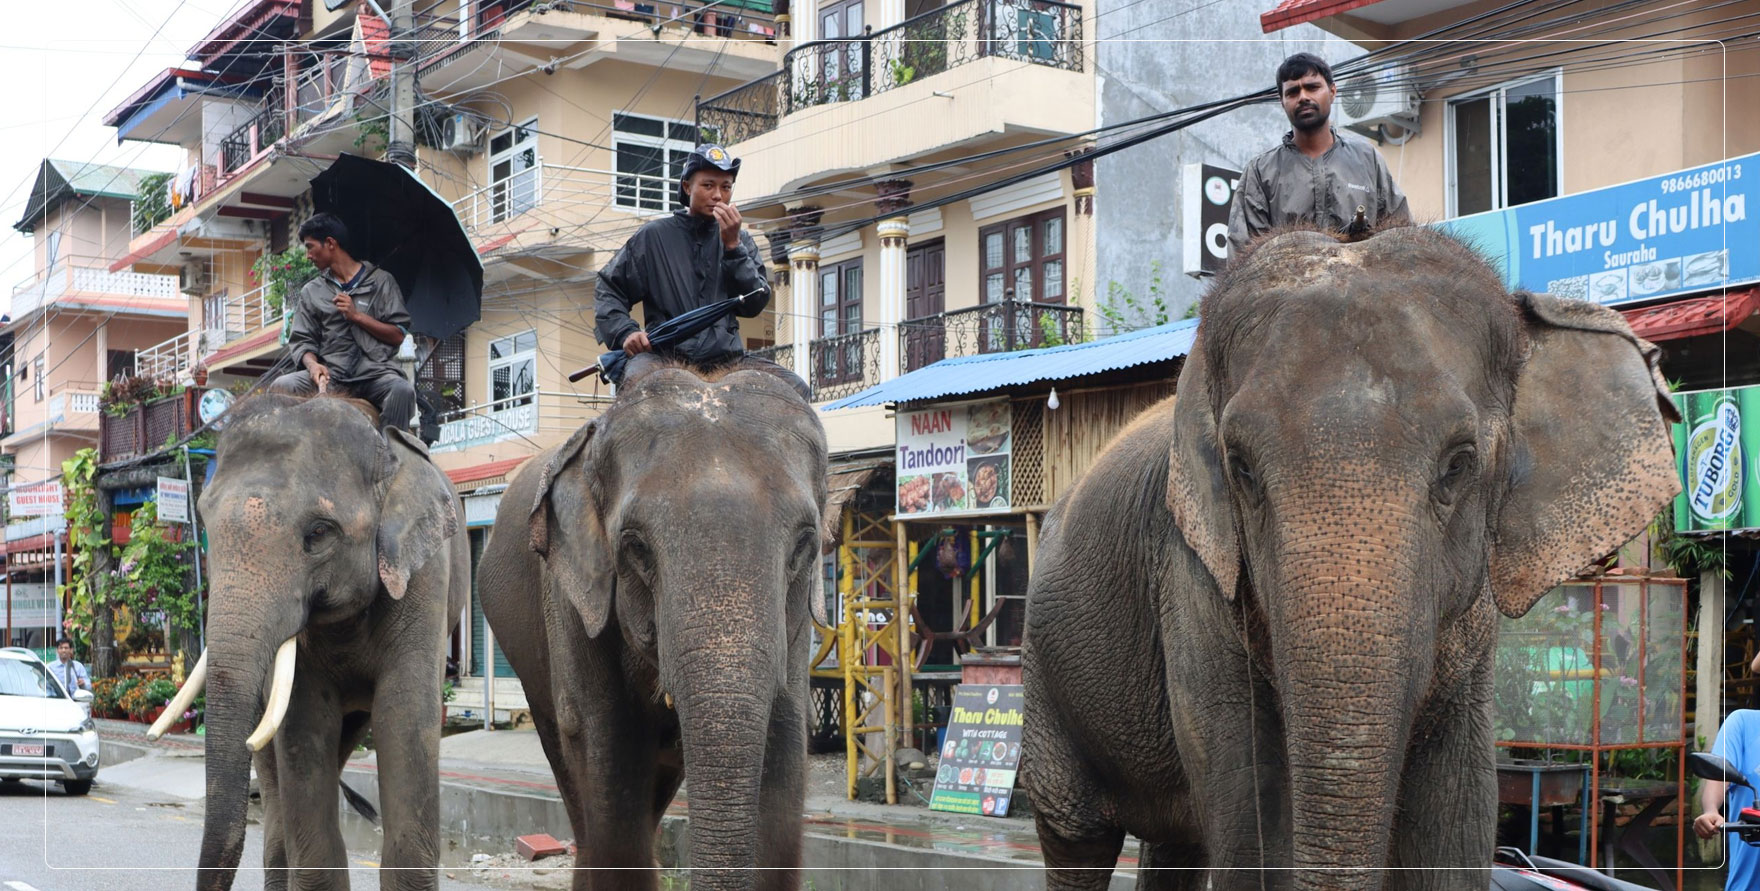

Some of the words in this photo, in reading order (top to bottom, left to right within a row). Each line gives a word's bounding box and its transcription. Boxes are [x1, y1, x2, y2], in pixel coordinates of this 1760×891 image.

[1661, 164, 1742, 194] 9866680013
[1530, 219, 1617, 260] Tharu
[1629, 188, 1746, 241] Chulha
[1604, 243, 1657, 269] Sauraha
[469, 415, 496, 440] GUEST
[499, 406, 531, 432] HOUSE
[911, 409, 952, 436] NAAN
[900, 438, 965, 470] Tandoori
[1694, 428, 1734, 510] TUBORG
[16, 495, 37, 504] GUEST
[38, 494, 60, 504] HOUSE
[1729, 472, 1739, 498] GOLD
[953, 707, 984, 724] Tharu
